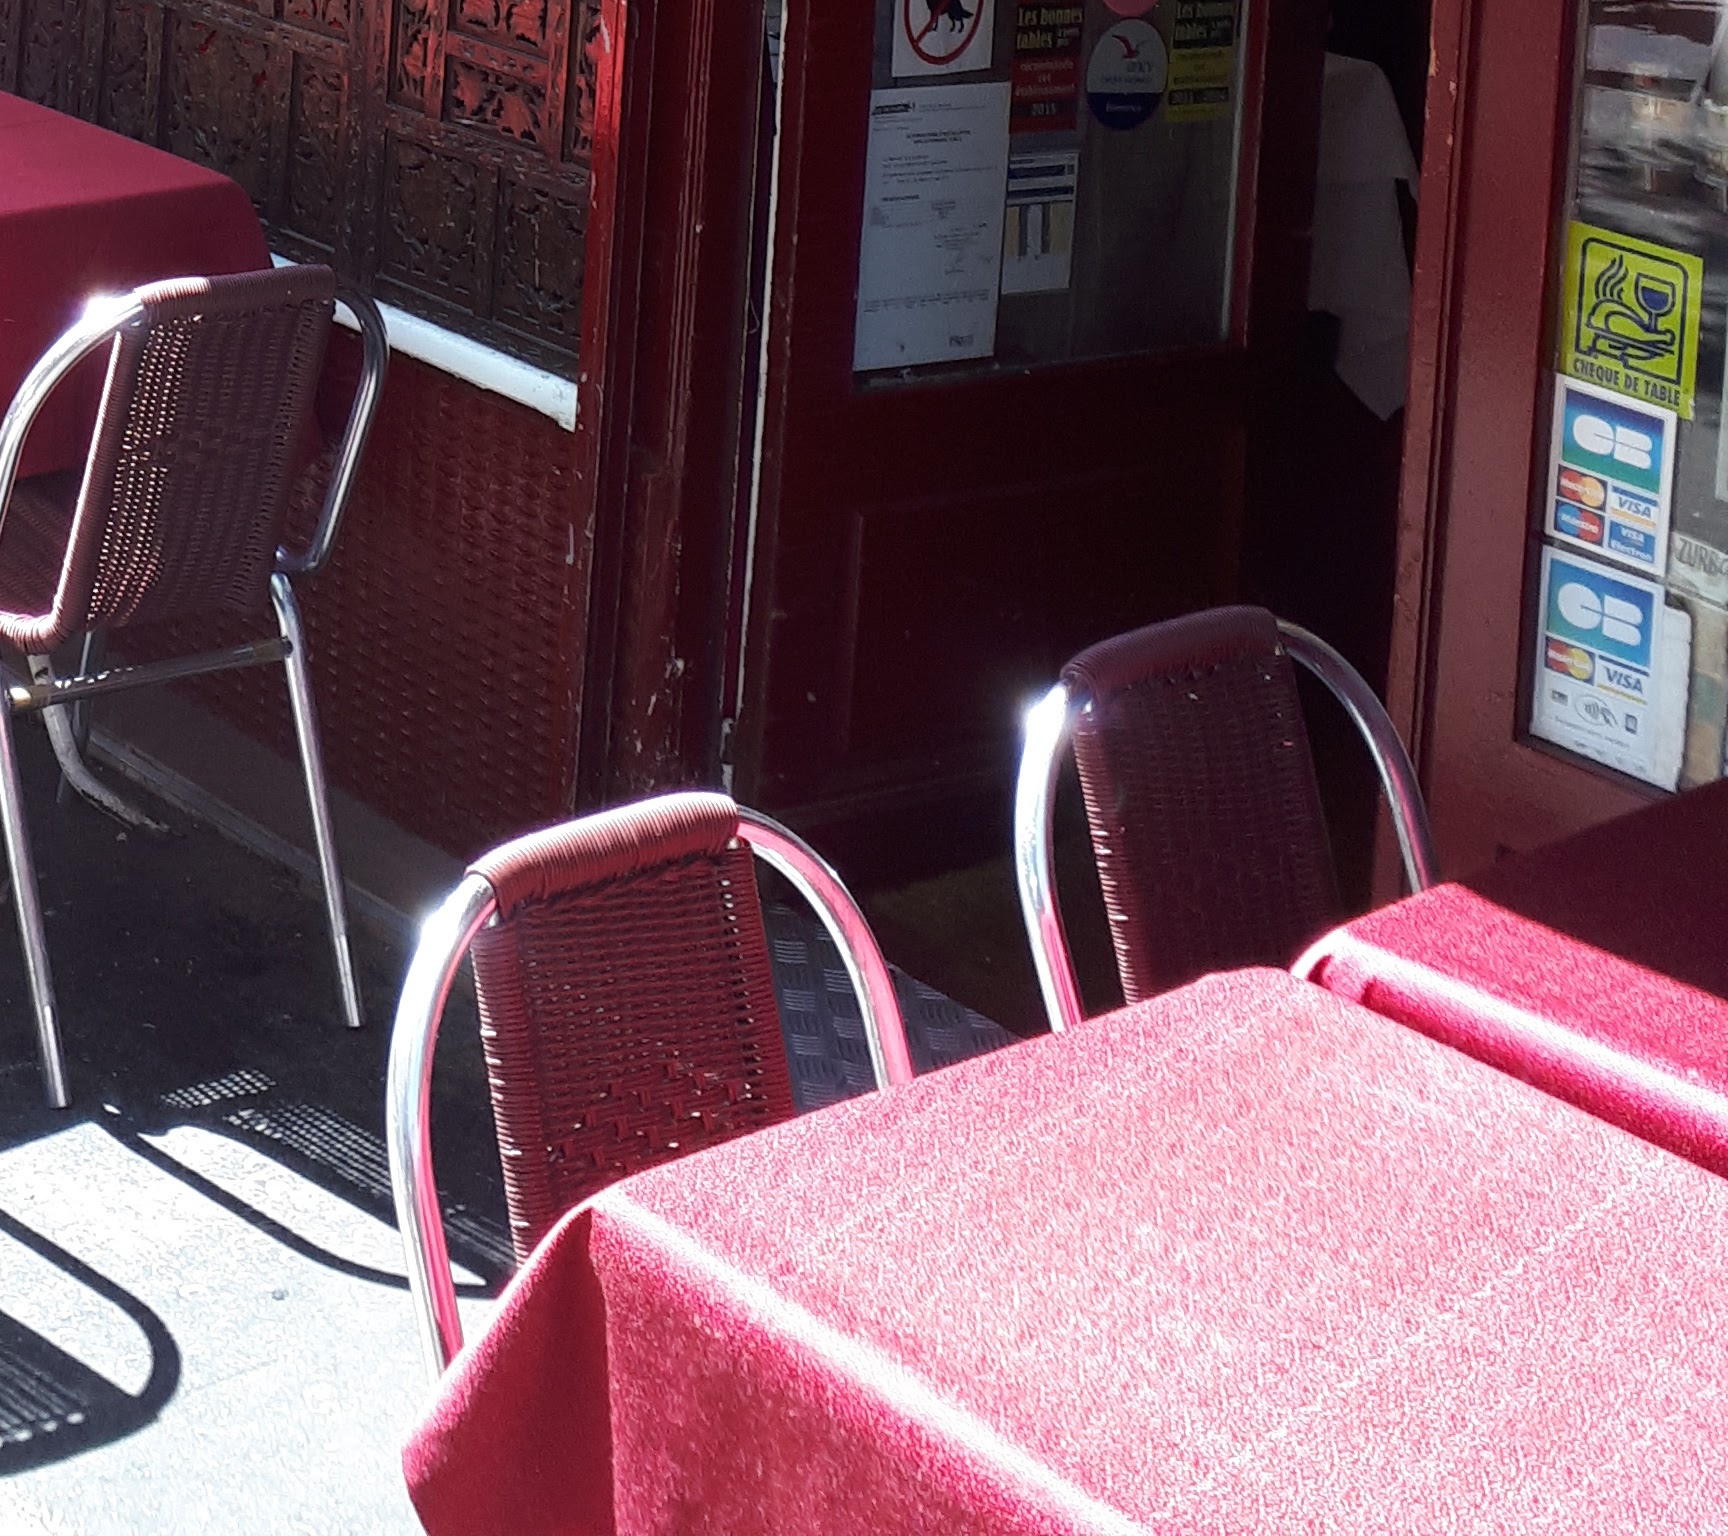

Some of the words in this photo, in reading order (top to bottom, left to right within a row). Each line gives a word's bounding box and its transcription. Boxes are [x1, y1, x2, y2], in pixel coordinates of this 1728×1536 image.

[1623, 371, 1641, 394] DE
[1643, 378, 1681, 407] TABLE
[1618, 495, 1652, 519] VISA
[1620, 525, 1646, 542] VISA
[1609, 538, 1655, 563] Electron
[1603, 665, 1644, 695] VISA
